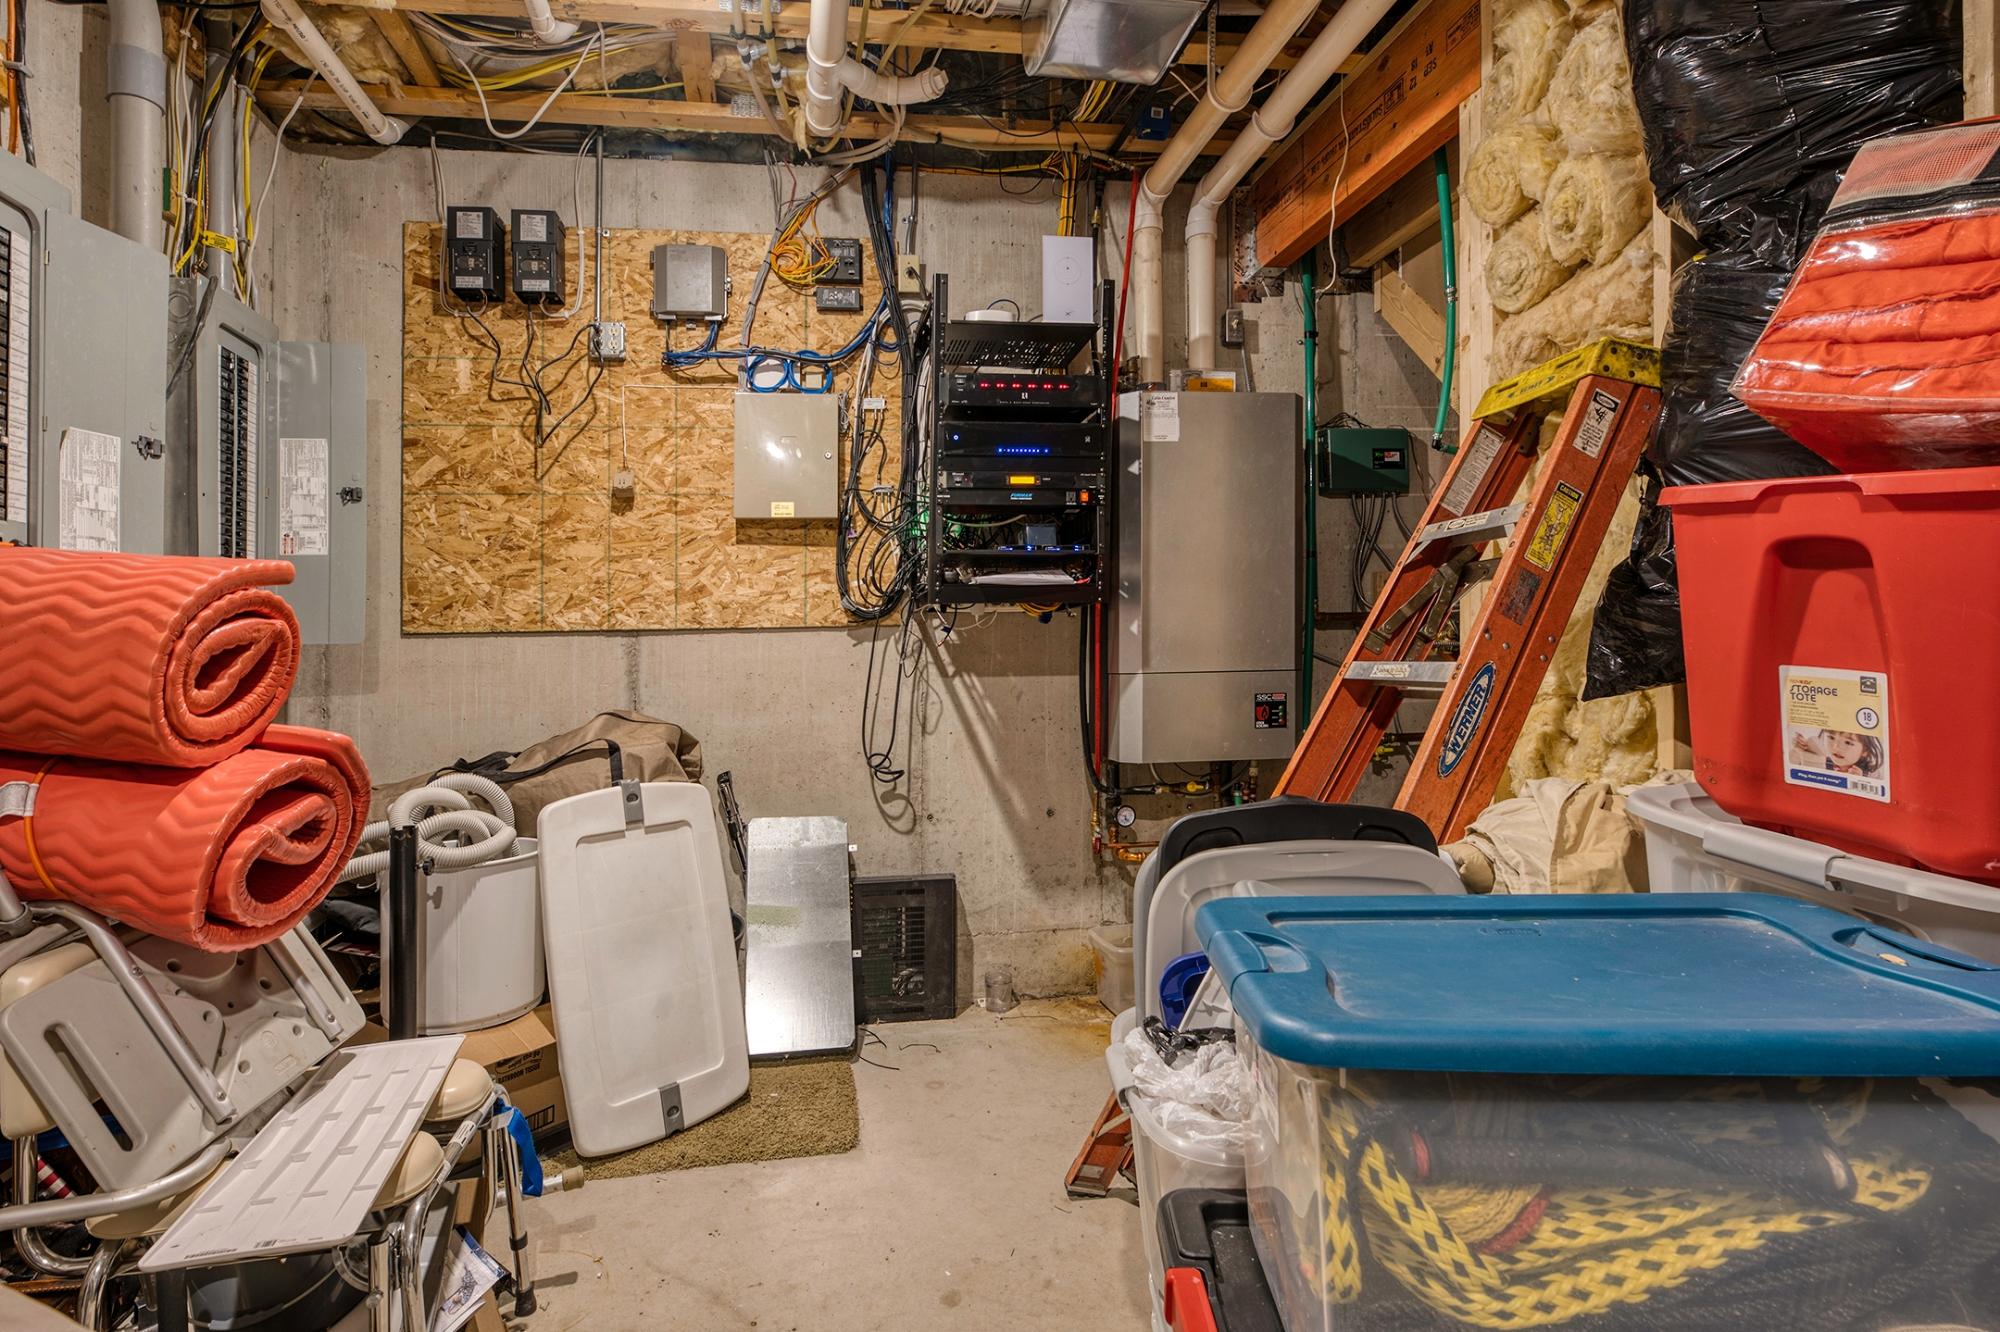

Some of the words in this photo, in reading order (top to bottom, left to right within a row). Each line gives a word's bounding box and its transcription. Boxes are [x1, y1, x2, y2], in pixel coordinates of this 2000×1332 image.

[1423, 57, 1438, 78] SEP
[1789, 684, 1838, 697] STORAGE
[1790, 692, 1817, 703] TOTE
[1448, 683, 1487, 754] WERNER
[1863, 711, 1872, 722] 18
